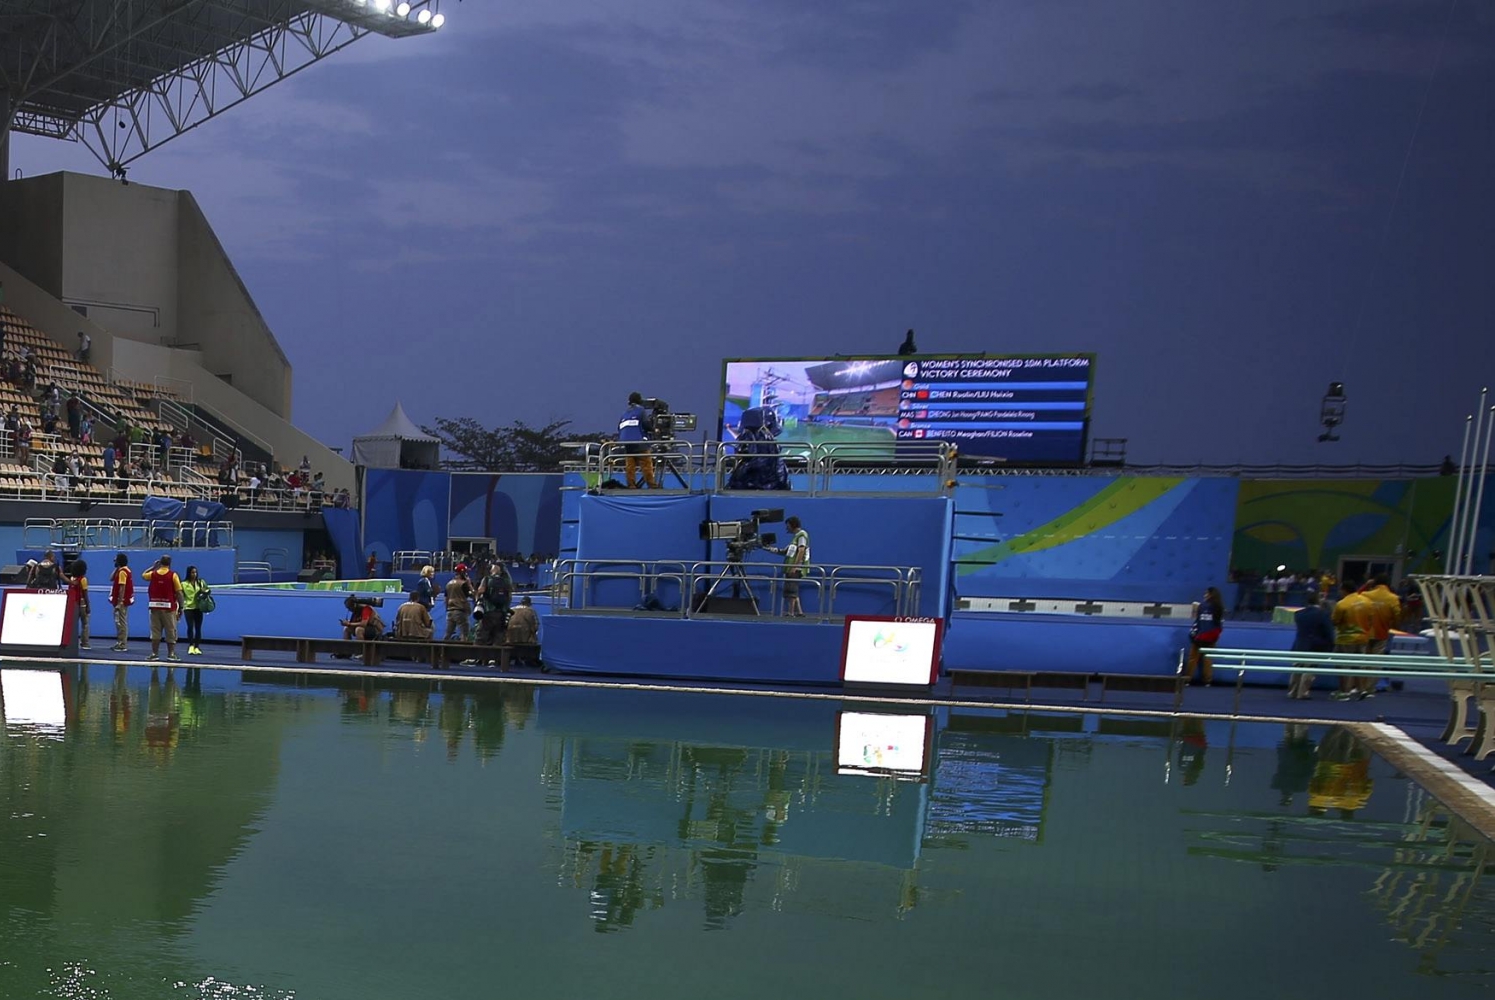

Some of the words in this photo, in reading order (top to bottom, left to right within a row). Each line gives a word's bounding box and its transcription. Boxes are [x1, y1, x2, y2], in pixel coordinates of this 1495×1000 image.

[921, 360, 960, 369] WOMEN'S
[960, 359, 1024, 369] SYNCHRONISED
[1043, 359, 1089, 368] PLATFORM
[919, 369, 960, 379] VICTORY
[960, 369, 1012, 378] CEREMONY
[898, 430, 914, 438] CAN
[904, 616, 936, 624] OMEGA
